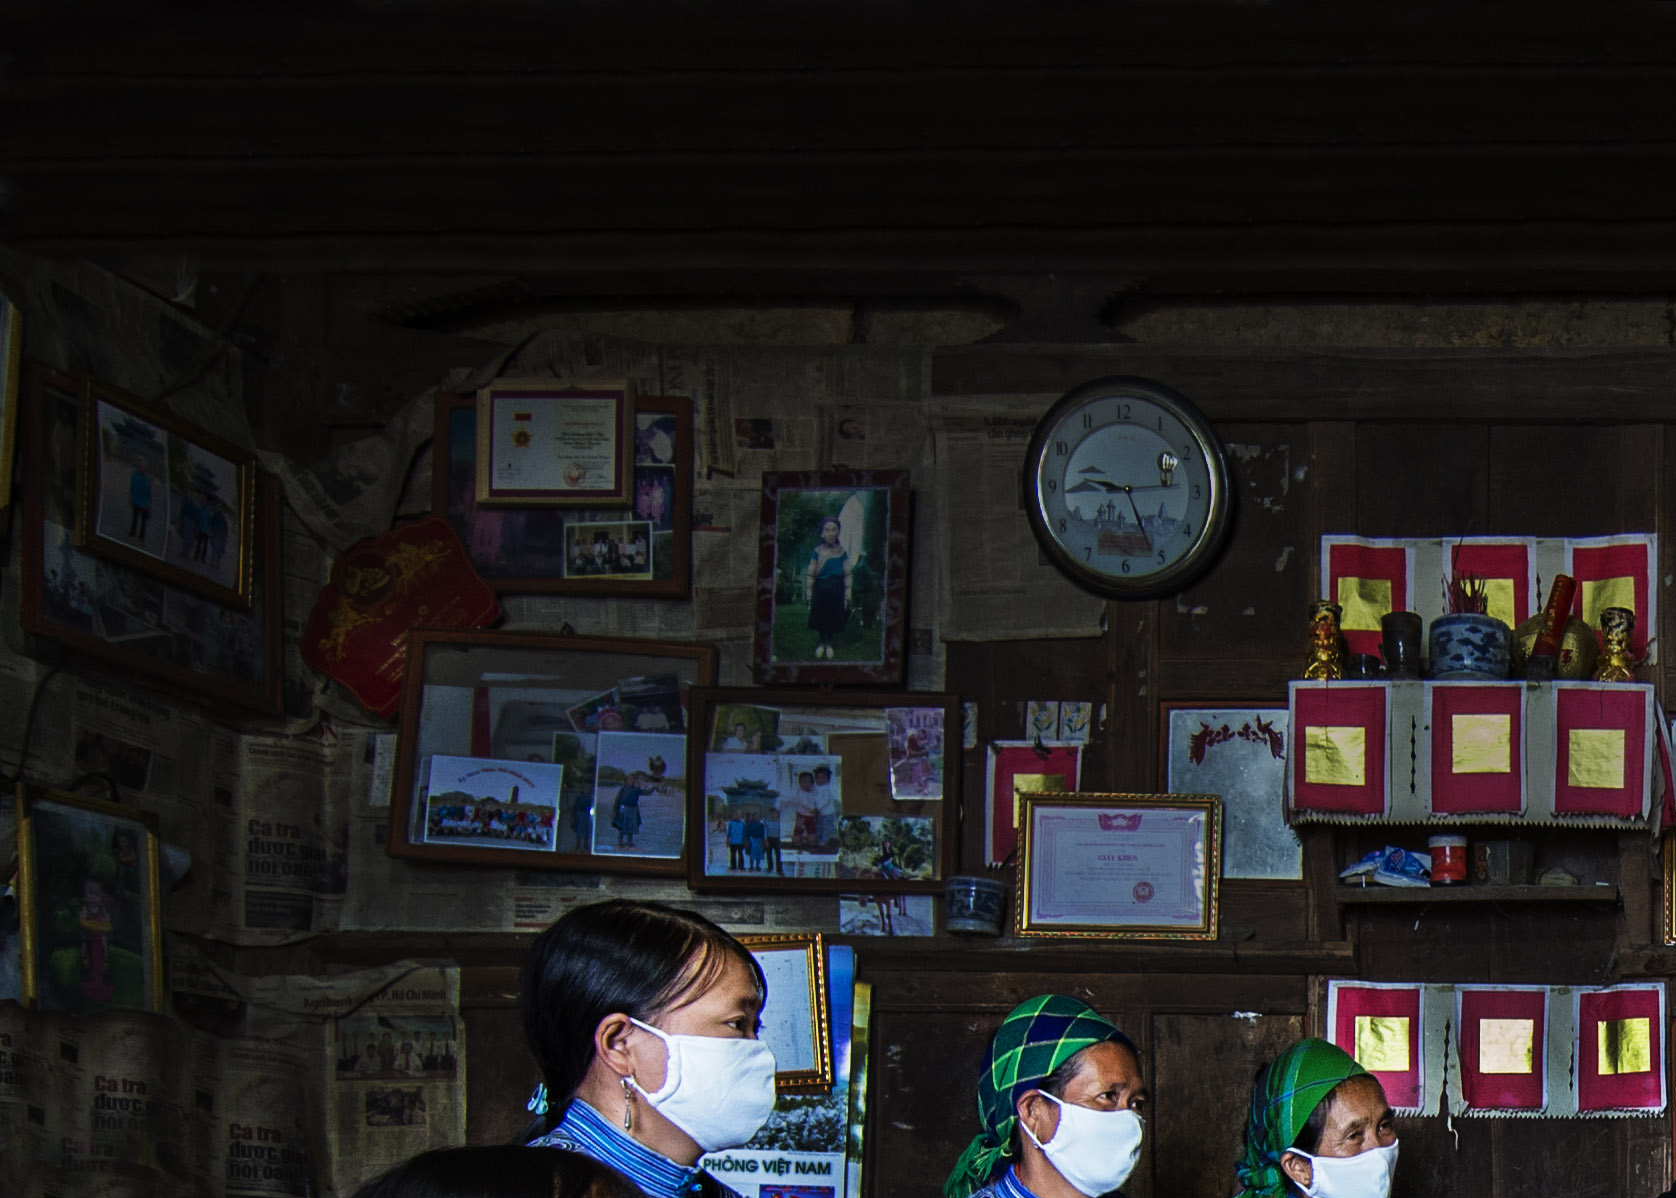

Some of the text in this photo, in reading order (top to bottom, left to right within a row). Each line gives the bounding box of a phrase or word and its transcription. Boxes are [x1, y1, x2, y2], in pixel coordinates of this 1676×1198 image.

[1116, 404, 1131, 420] 12
[1083, 414, 1092, 429] 11
[1157, 416, 1163, 432] 1
[1055, 441, 1068, 457] 10
[1183, 446, 1191, 461] 2
[1048, 480, 1057, 494] 9
[1193, 485, 1201, 500] 3
[1059, 519, 1067, 533] 8
[1183, 524, 1191, 537] 4
[1084, 547, 1092, 562] 7
[1157, 550, 1166, 565] 5
[1121, 561, 1130, 574] 6
[275, 821, 301, 840] tra
[303, 991, 352, 1010] Agribank
[122, 1077, 147, 1096] tra
[256, 1124, 282, 1144] tra
[704, 1156, 832, 1176] PHÒNG VIỆT NAM
